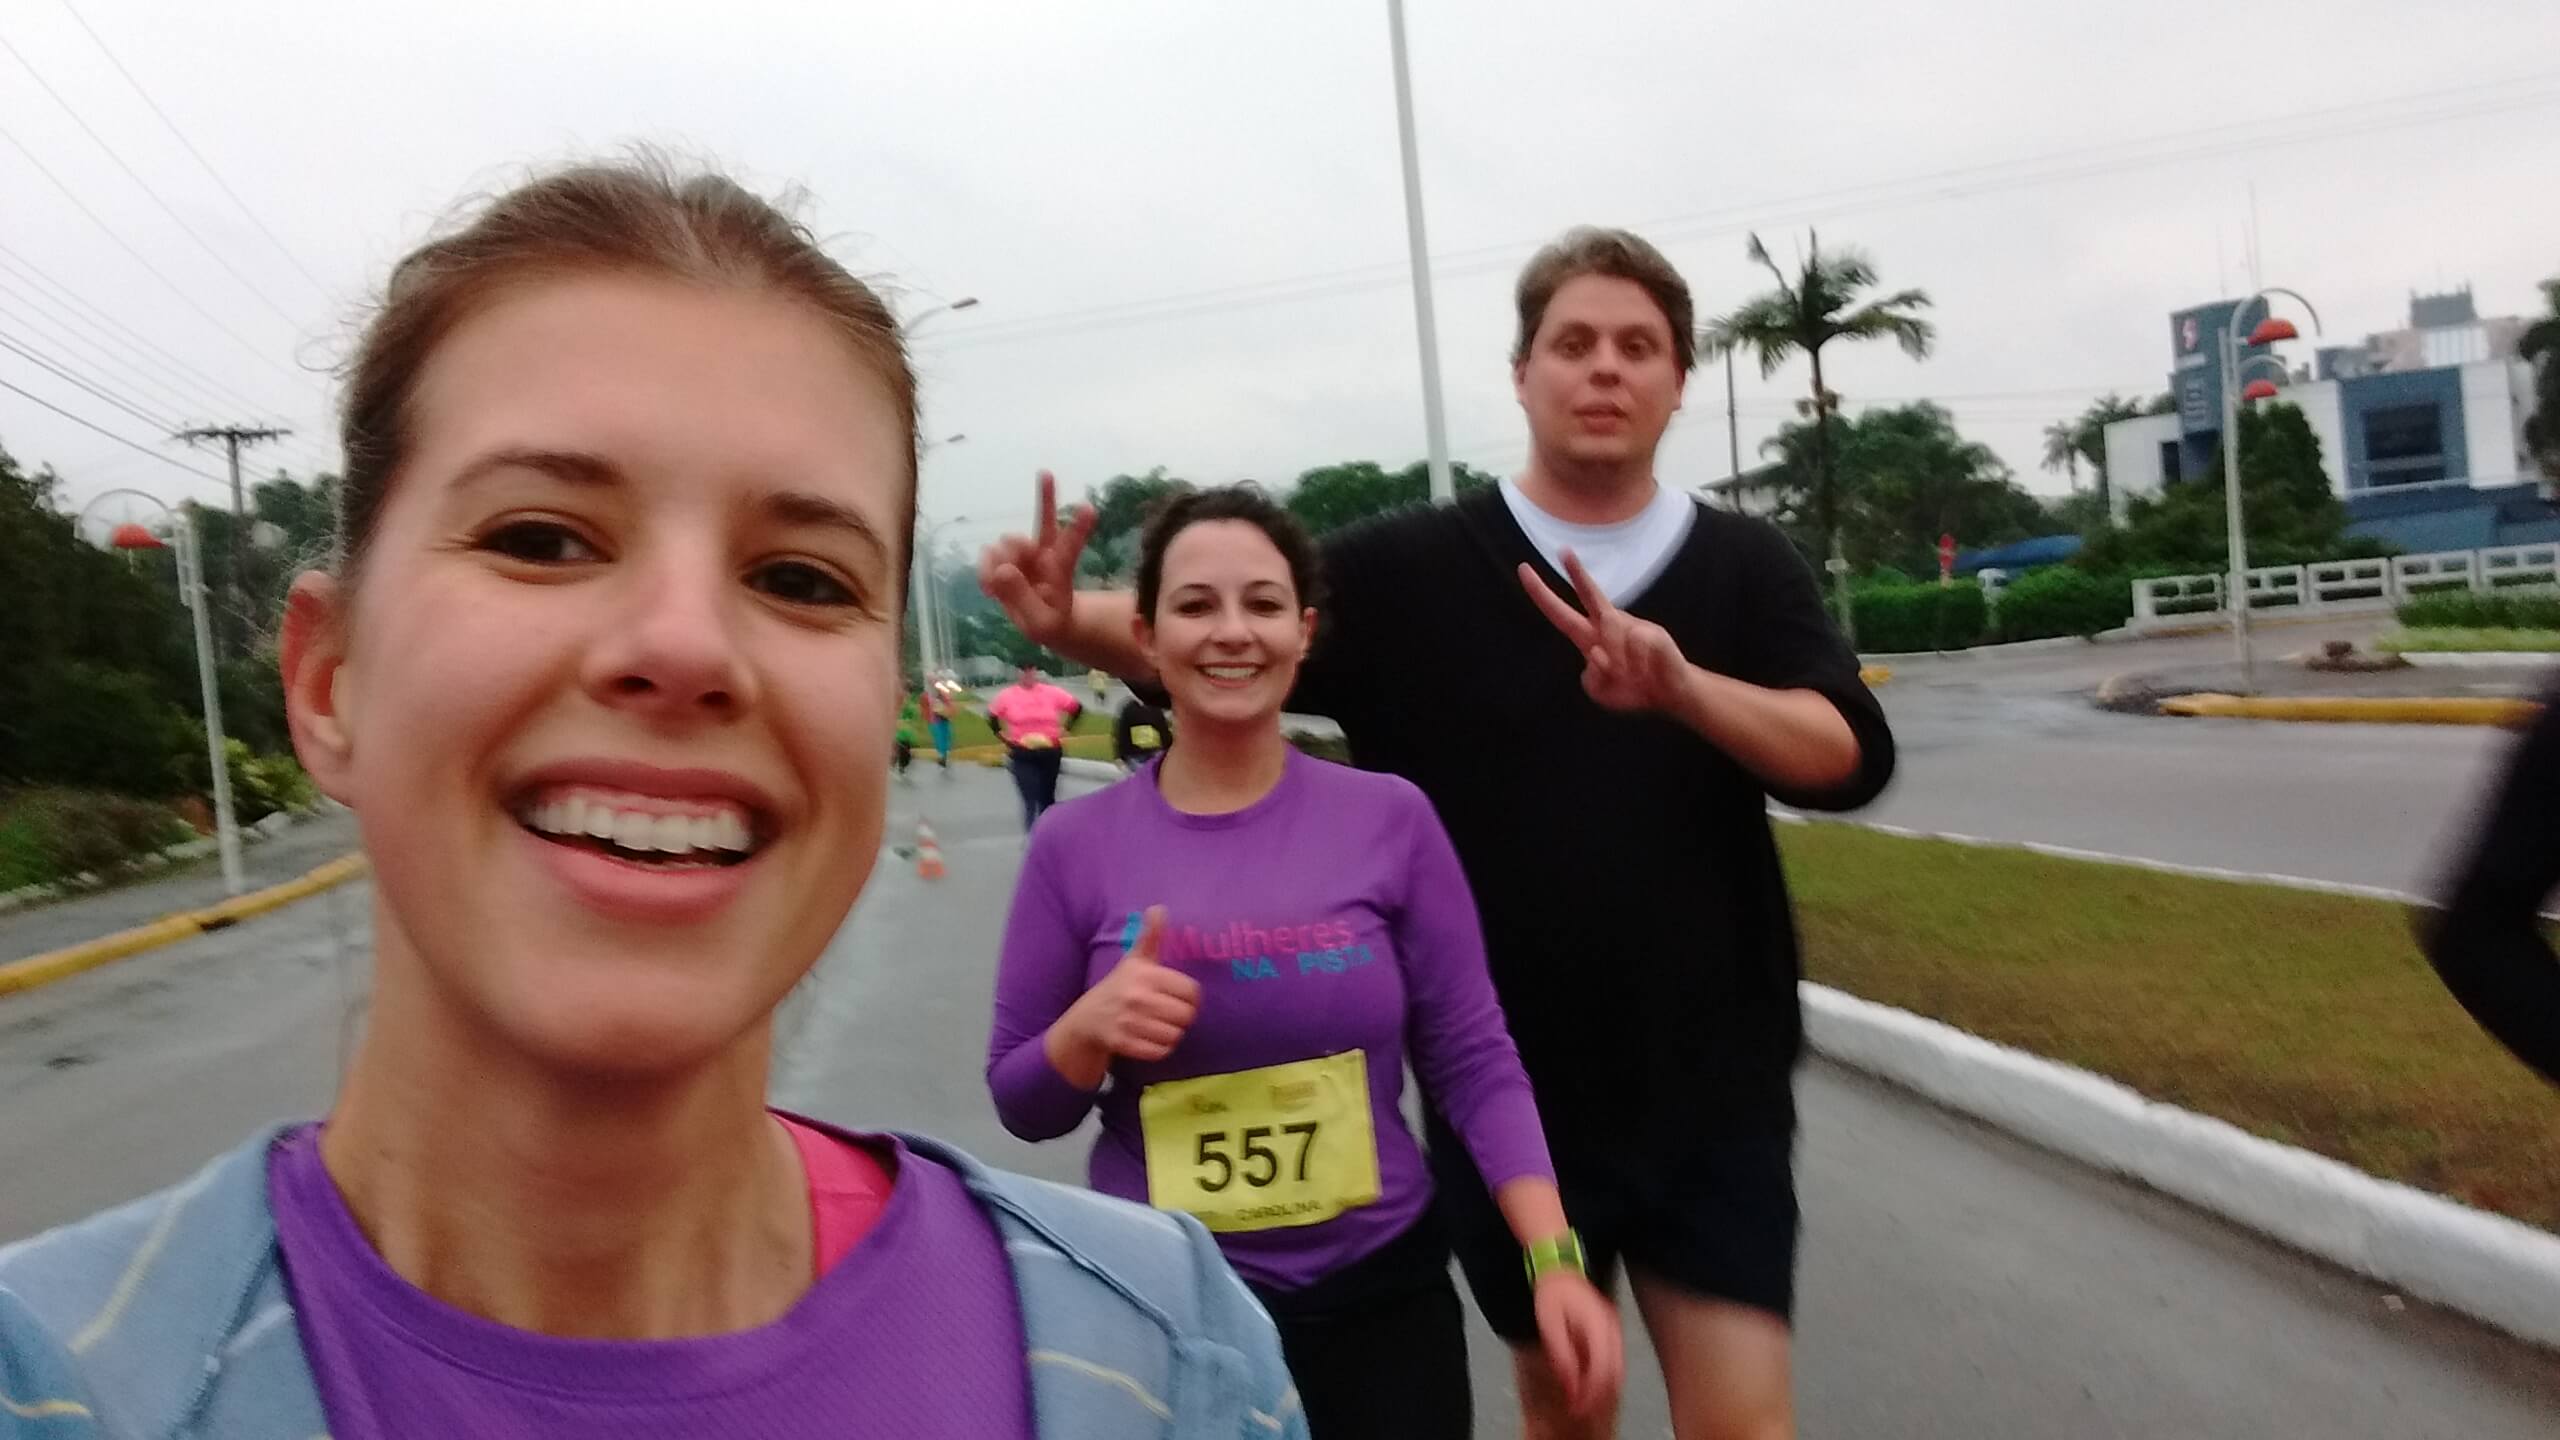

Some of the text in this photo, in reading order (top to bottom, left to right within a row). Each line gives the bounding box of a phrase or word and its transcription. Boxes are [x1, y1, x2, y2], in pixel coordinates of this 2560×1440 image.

[1162, 920, 1353, 961] Mulheres
[1231, 956, 1280, 981] NA
[1195, 1121, 1318, 1192] 557
